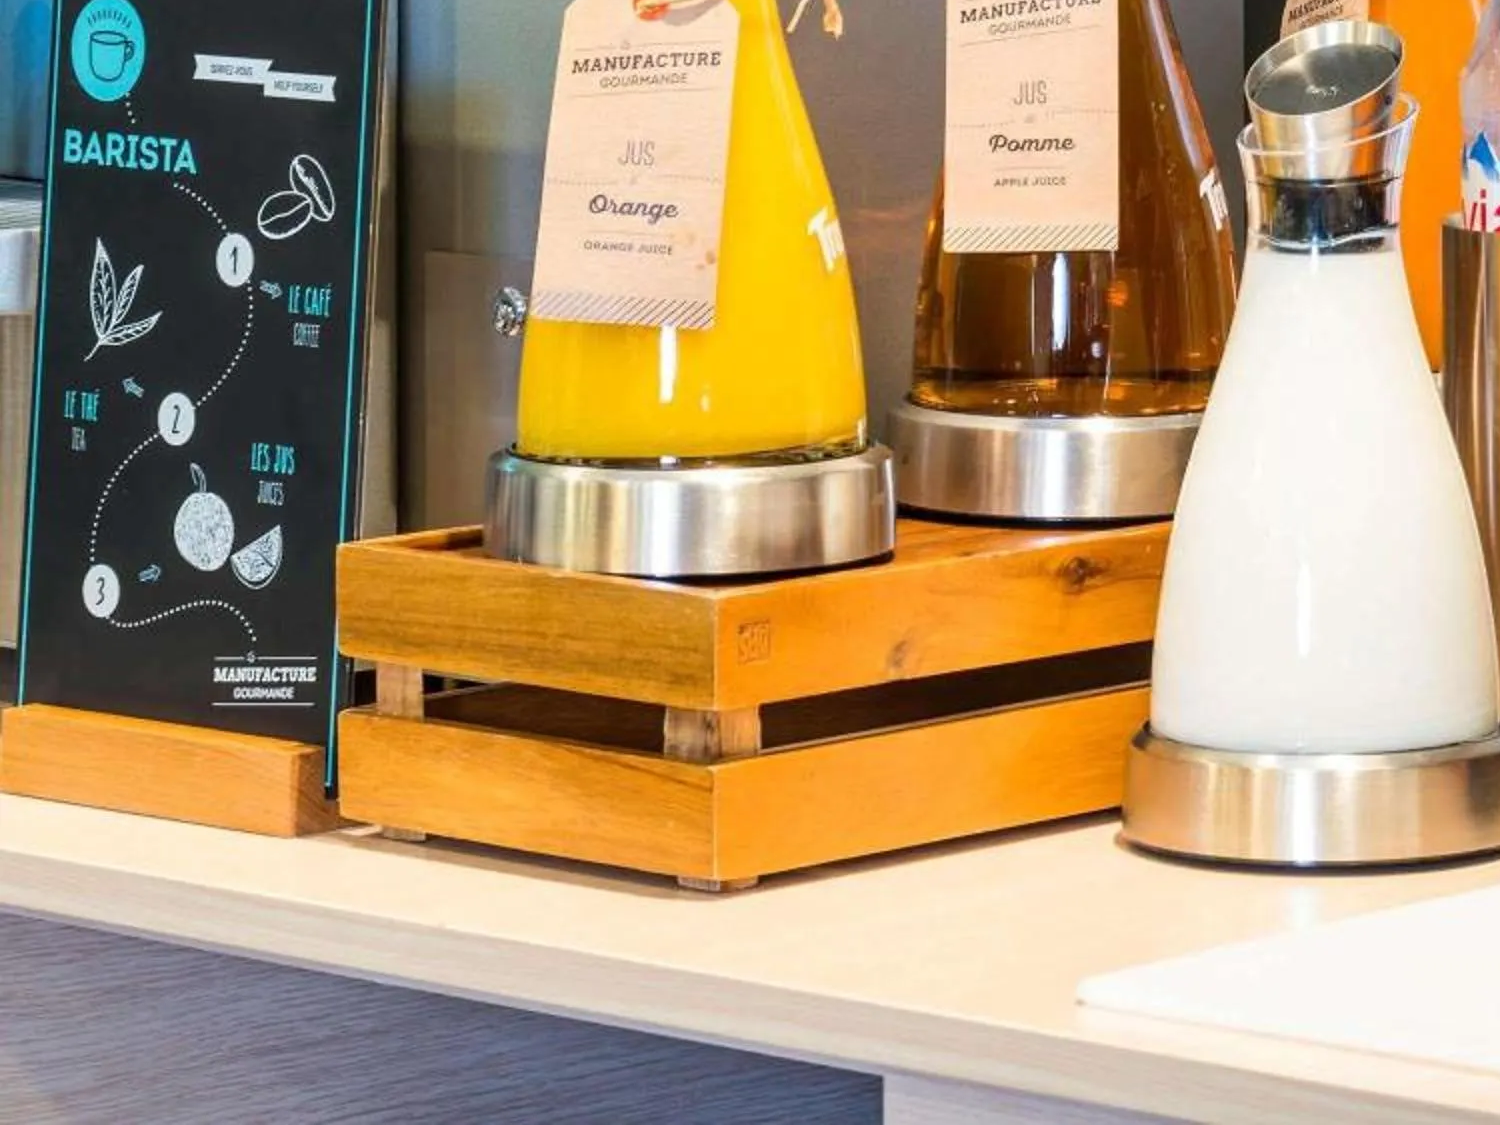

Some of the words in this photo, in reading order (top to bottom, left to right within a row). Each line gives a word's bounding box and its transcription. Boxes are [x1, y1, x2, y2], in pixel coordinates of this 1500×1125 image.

[988, 13, 1072, 35] GOURMANDE
[571, 51, 721, 74] MANUFACTURE
[600, 73, 688, 88] GOURMANDE
[1013, 80, 1047, 106] JUS
[63, 128, 198, 174] BARISTA
[618, 141, 655, 167] JUS
[988, 134, 1075, 153] Pomme
[589, 194, 679, 223] Orange
[229, 246, 238, 275] 1
[171, 404, 181, 434] 2
[94, 576, 106, 606] 3
[213, 667, 317, 682] MANUFACTURE
[233, 686, 294, 699] GOURMANDE
